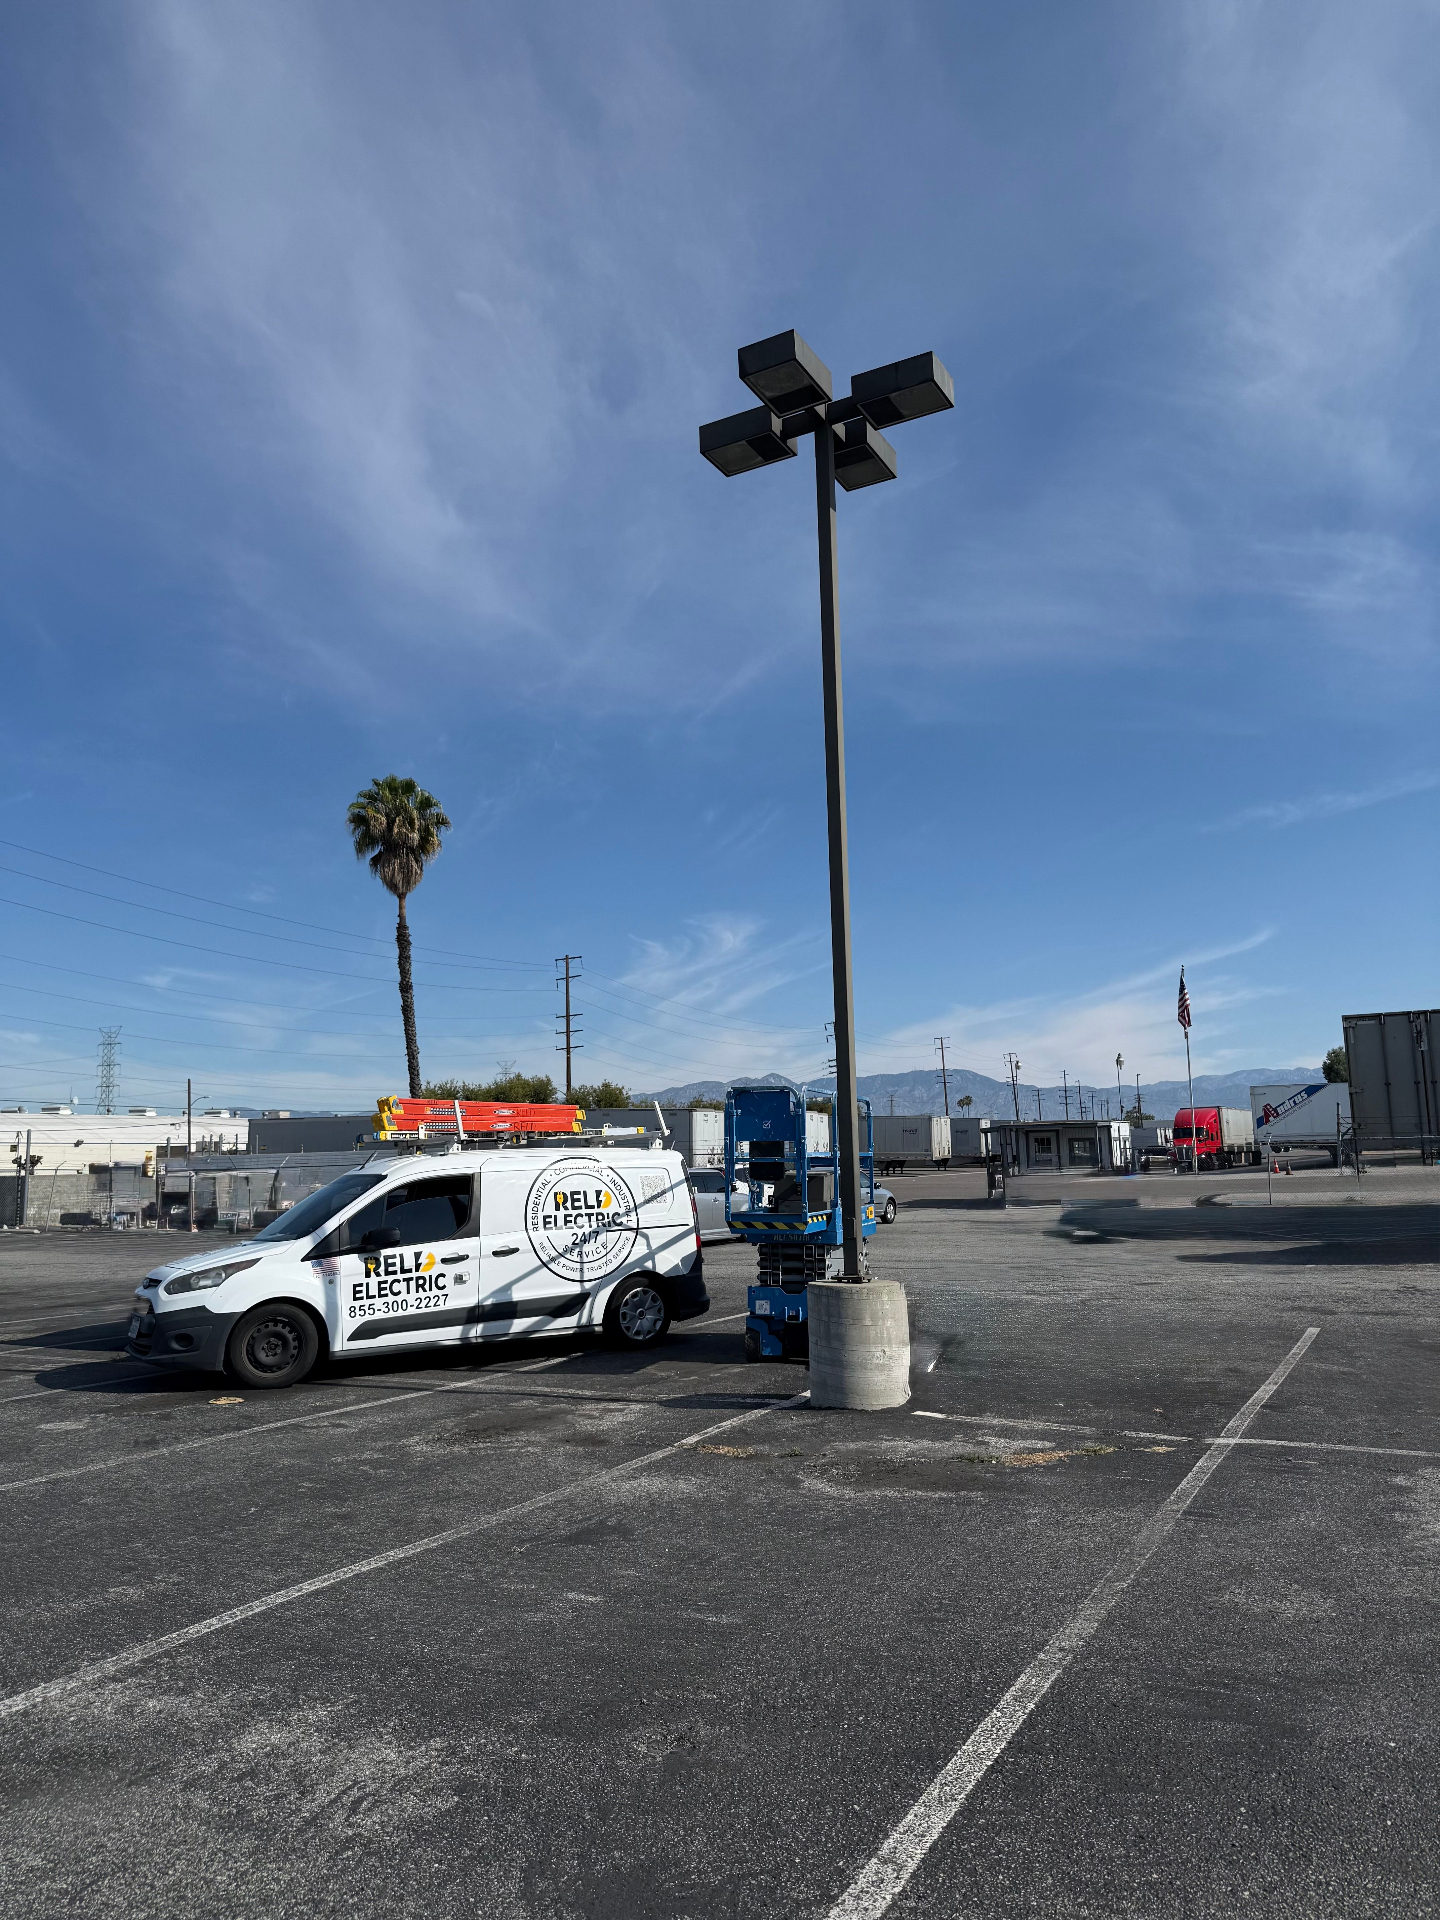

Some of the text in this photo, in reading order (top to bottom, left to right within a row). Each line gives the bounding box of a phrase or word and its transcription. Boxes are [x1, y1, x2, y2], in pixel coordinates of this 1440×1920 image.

[1263, 1090, 1308, 1125] Andrus
[531, 1178, 551, 1232] RESIDENTIAL
[609, 1177, 633, 1224] INDUSTRIAL
[543, 1211, 623, 1231] ELECTRIC
[563, 1241, 608, 1258] SERVICE
[571, 1231, 600, 1246] 24/7
[539, 1241, 561, 1266] RELIABLE
[586, 1258, 612, 1272] TRUSTED
[613, 1236, 631, 1259] SERVICE
[353, 1273, 447, 1301] ELECTRIC
[349, 1294, 449, 1318] 855-300-2227
